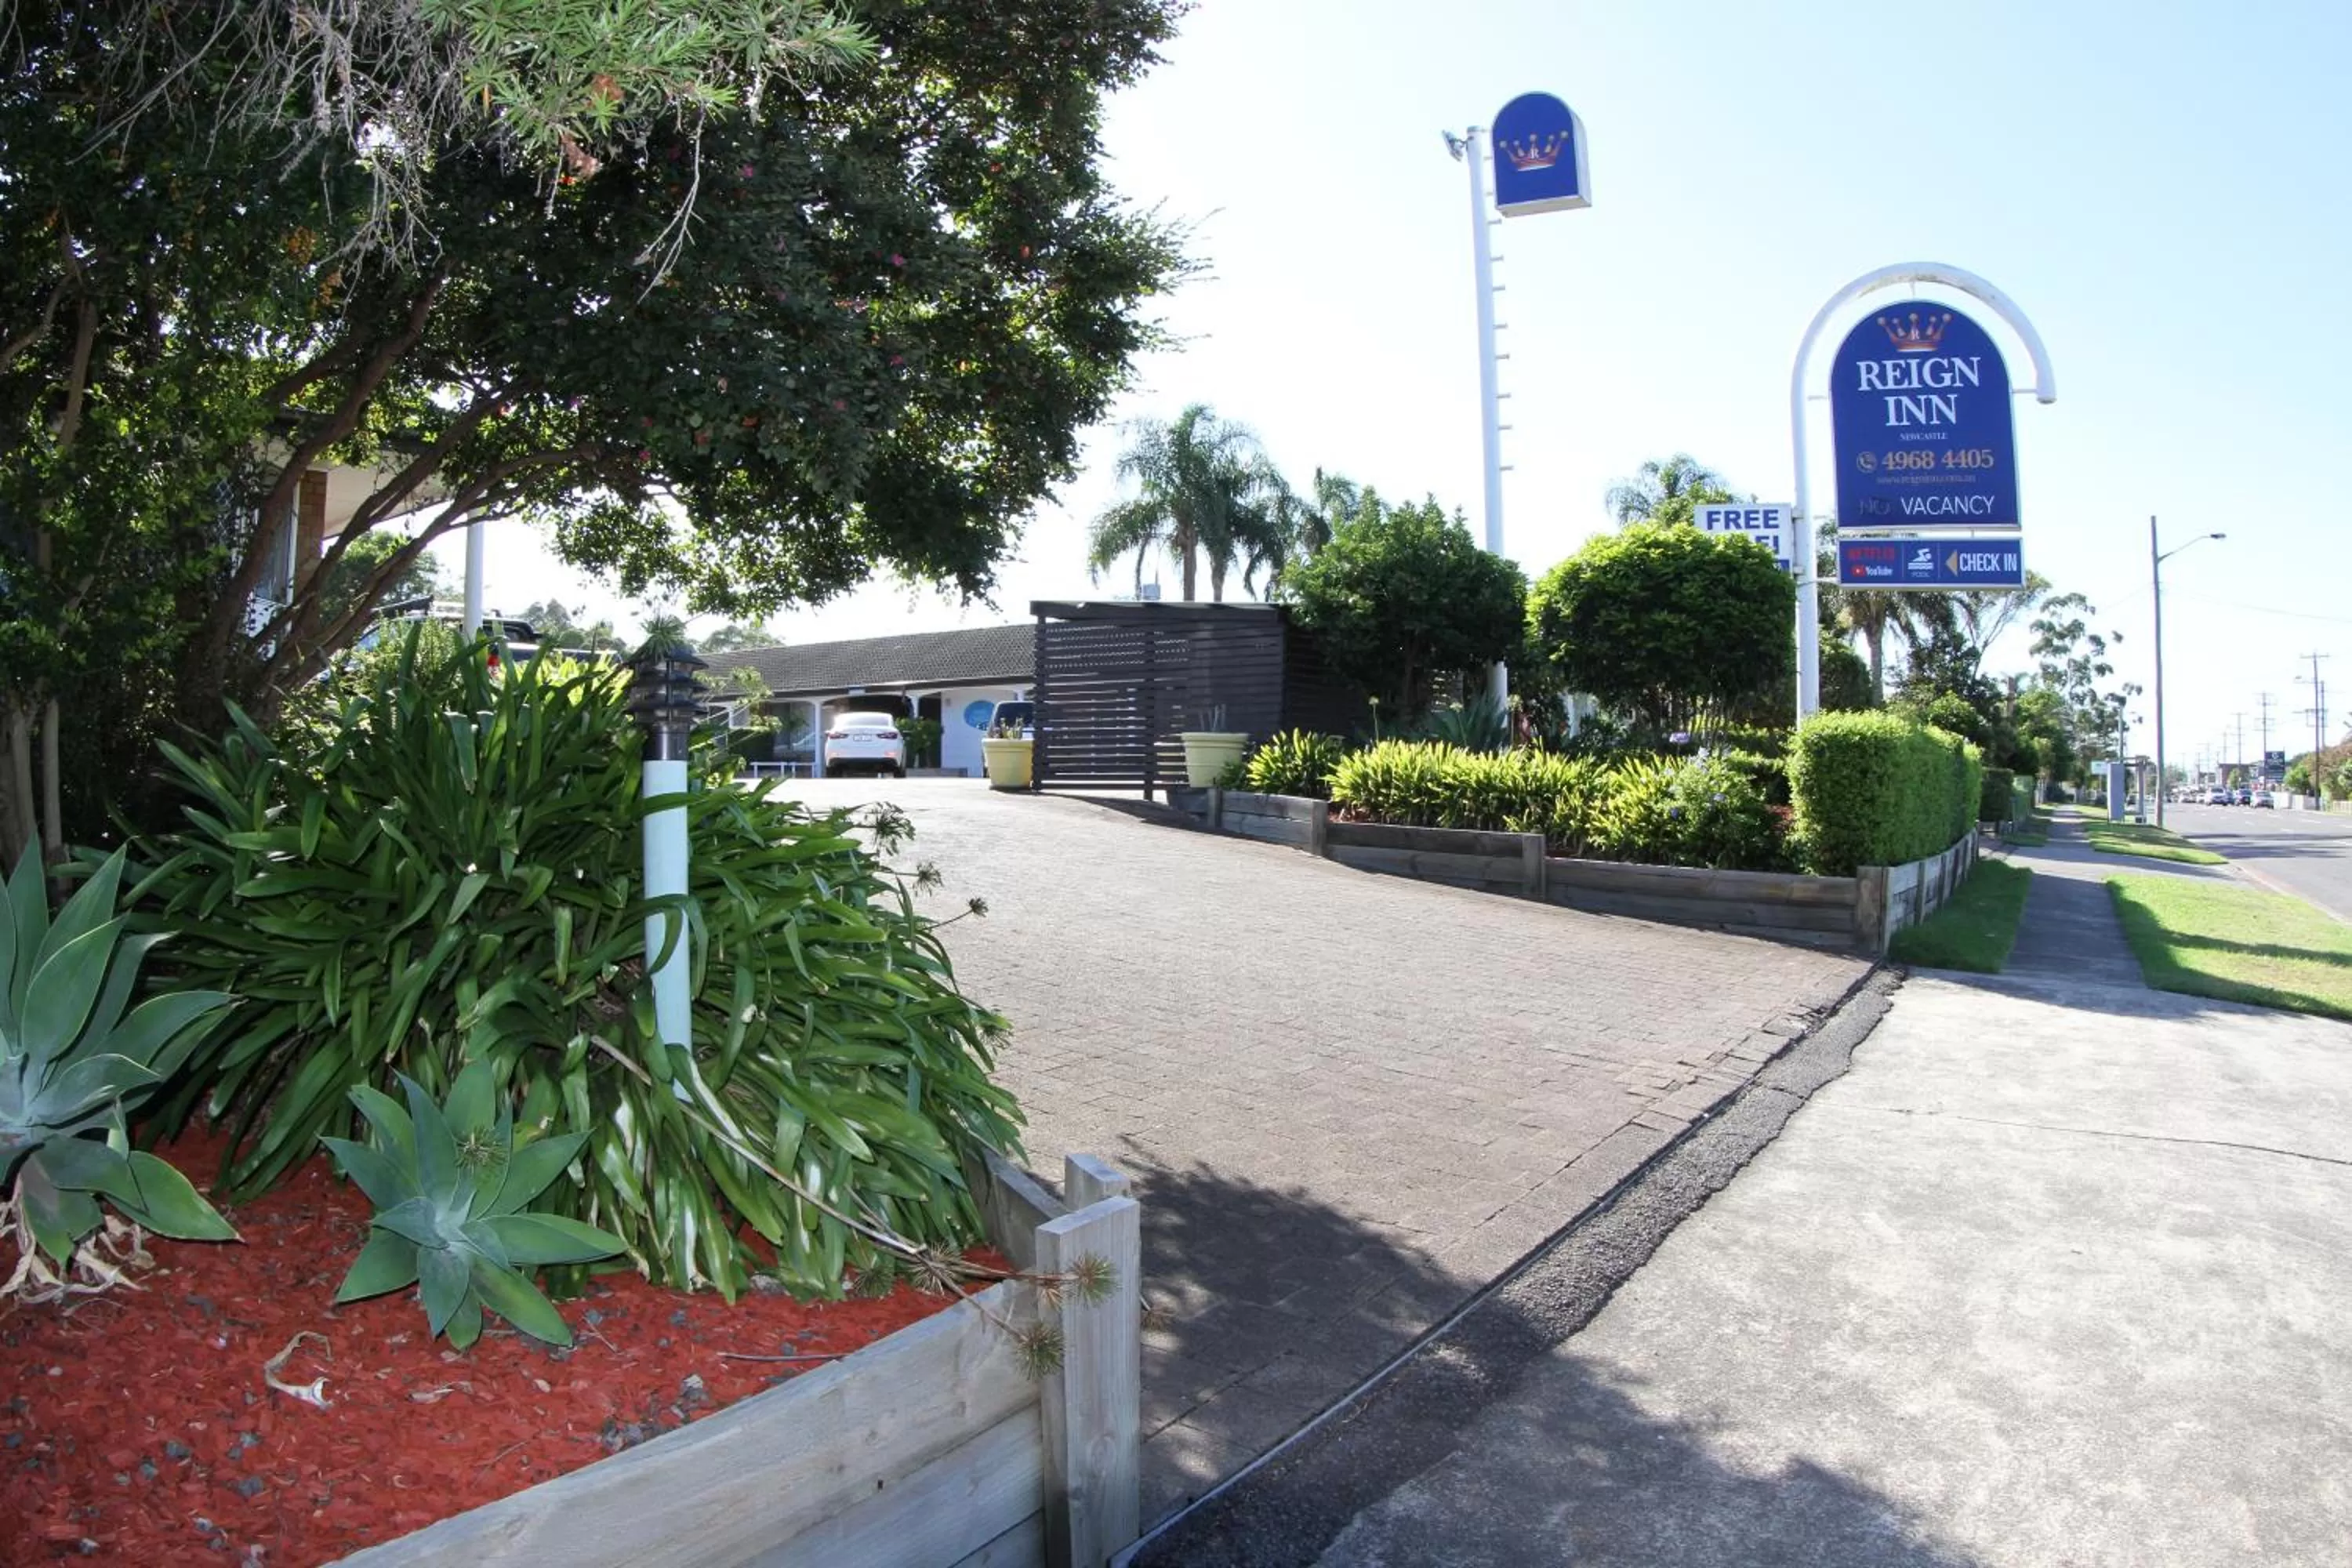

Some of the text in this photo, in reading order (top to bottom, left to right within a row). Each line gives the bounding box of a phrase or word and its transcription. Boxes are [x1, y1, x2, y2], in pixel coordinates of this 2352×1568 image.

[1857, 357, 1981, 391] REIGN
[1884, 394, 1958, 426] INN
[1882, 448, 1994, 470] 4968 4405
[1900, 495, 1995, 515] VACANCY
[1706, 509, 1780, 531] FREE
[1959, 553, 2017, 572] CHECK IN
